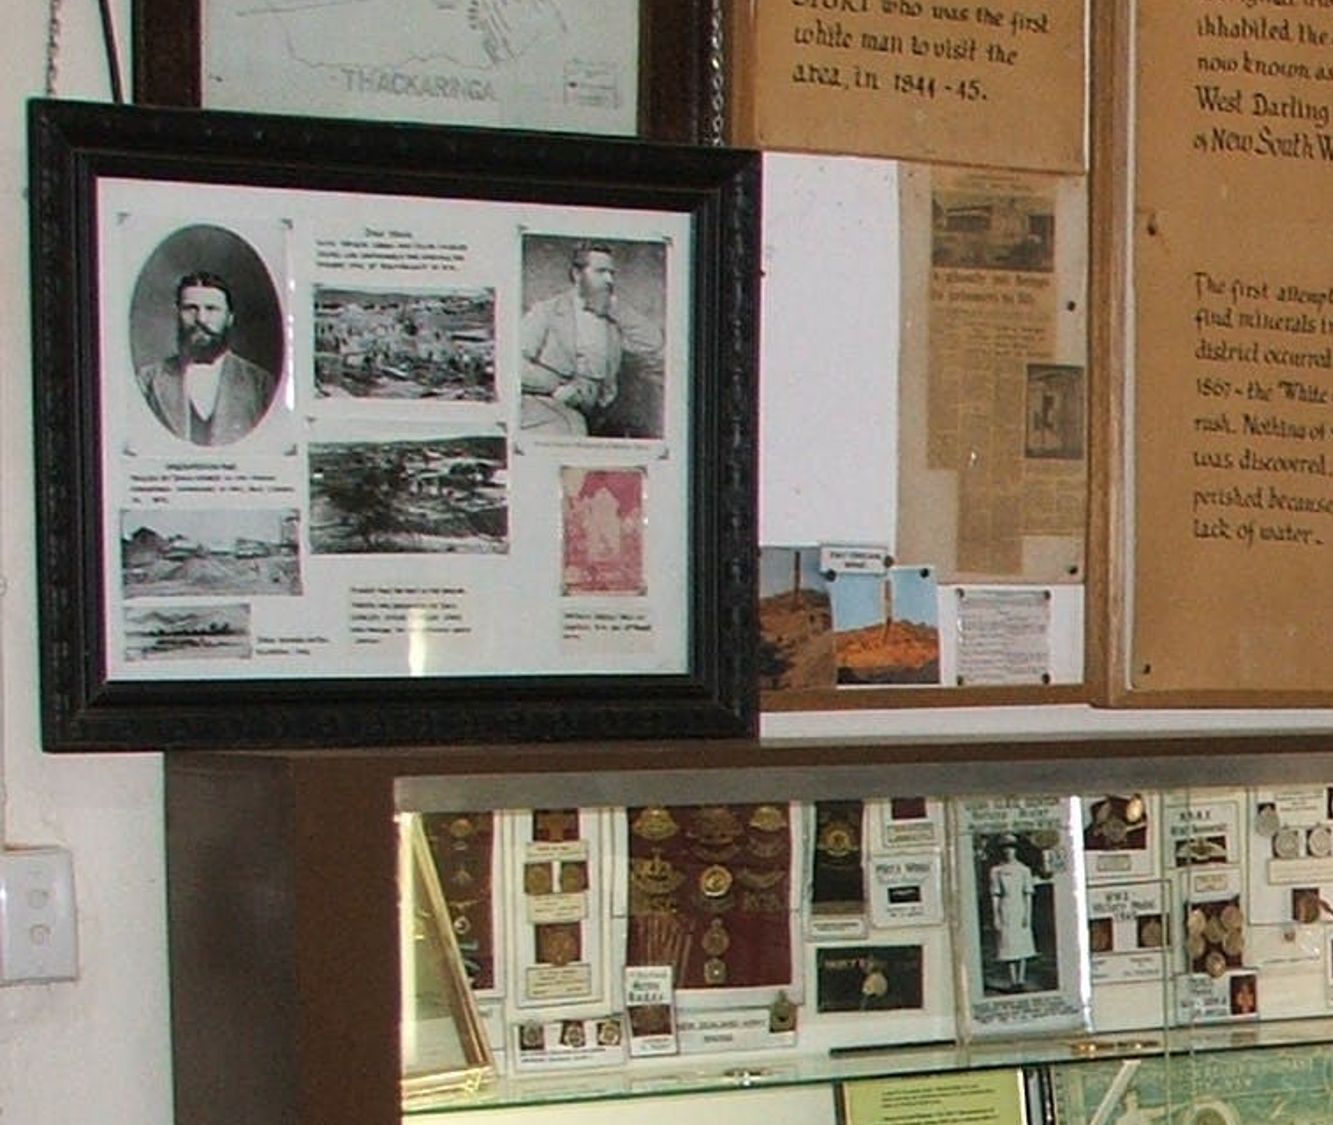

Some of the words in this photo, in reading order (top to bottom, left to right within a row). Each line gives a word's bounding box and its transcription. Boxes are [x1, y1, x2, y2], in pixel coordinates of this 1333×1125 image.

[976, 6, 1004, 27] the
[1010, 11, 1049, 35] first
[1298, 22, 1328, 46] the
[794, 19, 853, 49] white
[861, 31, 903, 54] man
[932, 37, 975, 61] visit
[986, 44, 1018, 66] the
[1197, 55, 1238, 72] now
[1243, 50, 1312, 80] known
[1194, 85, 1243, 115] West
[1251, 93, 1331, 128] Darling
[1211, 127, 1253, 152] New
[1254, 125, 1314, 160] South
[1194, 272, 1226, 297] The
[1231, 278, 1268, 304] first
